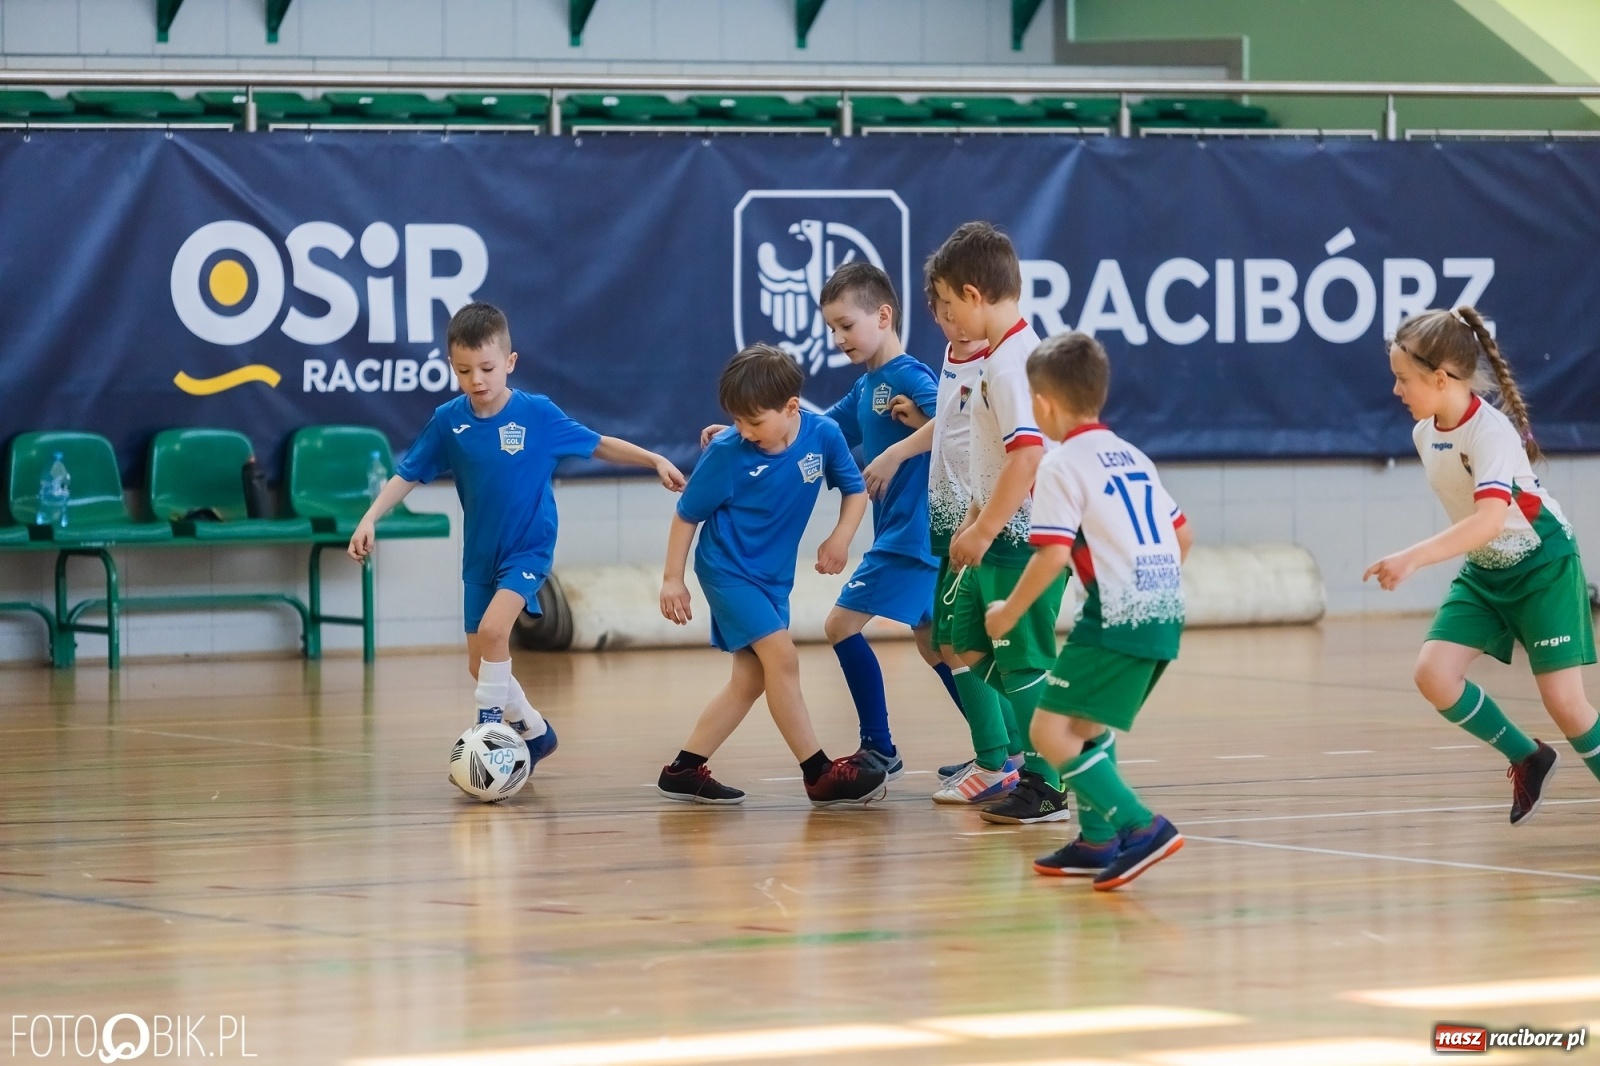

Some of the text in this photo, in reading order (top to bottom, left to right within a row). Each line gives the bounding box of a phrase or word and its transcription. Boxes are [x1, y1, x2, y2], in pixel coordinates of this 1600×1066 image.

[1019, 227, 1496, 345] RACIBÓRZ
[1431, 442, 1454, 451] regio
[1097, 451, 1136, 468] LEON
[1104, 472, 1162, 545] 17
[992, 639, 1011, 649] gio
[1534, 634, 1571, 648] regio
[483, 749, 515, 765] GOL
